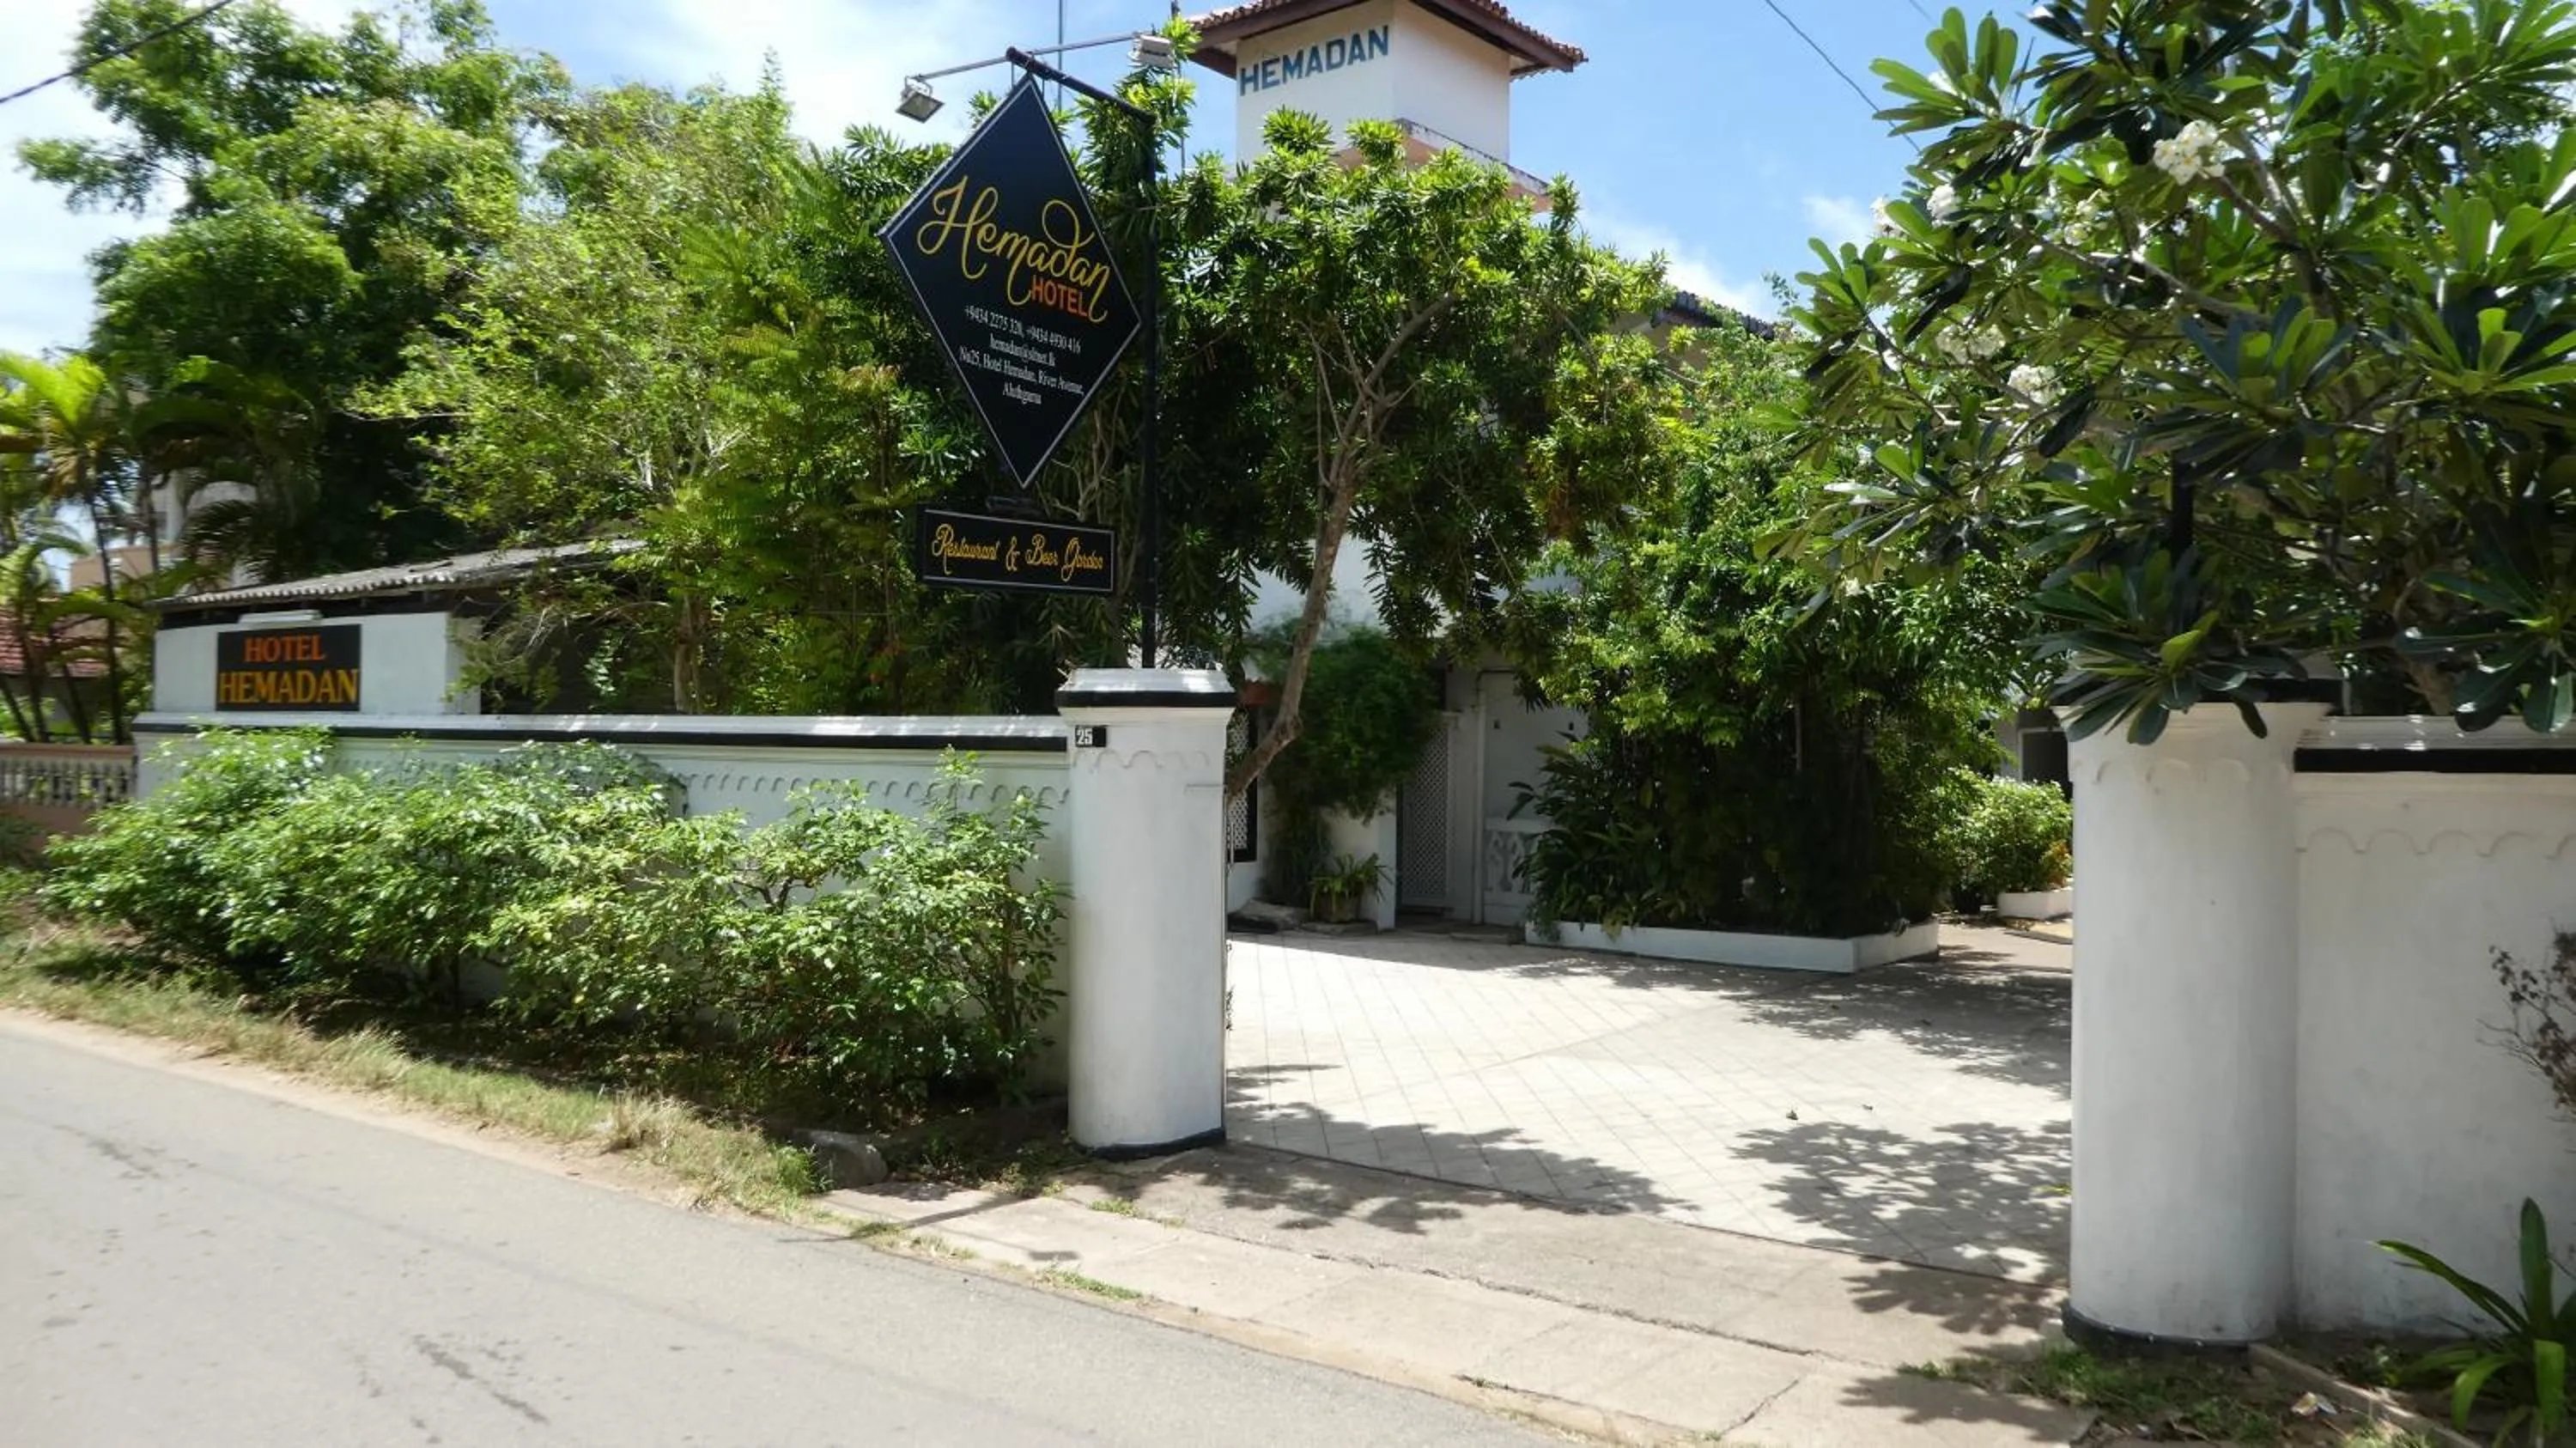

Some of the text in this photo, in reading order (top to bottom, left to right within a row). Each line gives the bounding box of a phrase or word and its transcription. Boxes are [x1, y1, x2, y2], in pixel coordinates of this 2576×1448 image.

[1240, 25, 1388, 96] HEMADAN
[917, 175, 1110, 322] Hemadan
[1031, 275, 1088, 317] HOTEL
[989, 312, 1009, 332] 2275
[983, 353, 1002, 372] Hotel
[1038, 369, 1057, 387] River
[932, 523, 1103, 582] Restaurant & Beer Garden
[244, 634, 325, 663] HOTEL
[218, 668, 359, 704] HEMADAN
[1076, 728, 1093, 746] 25
